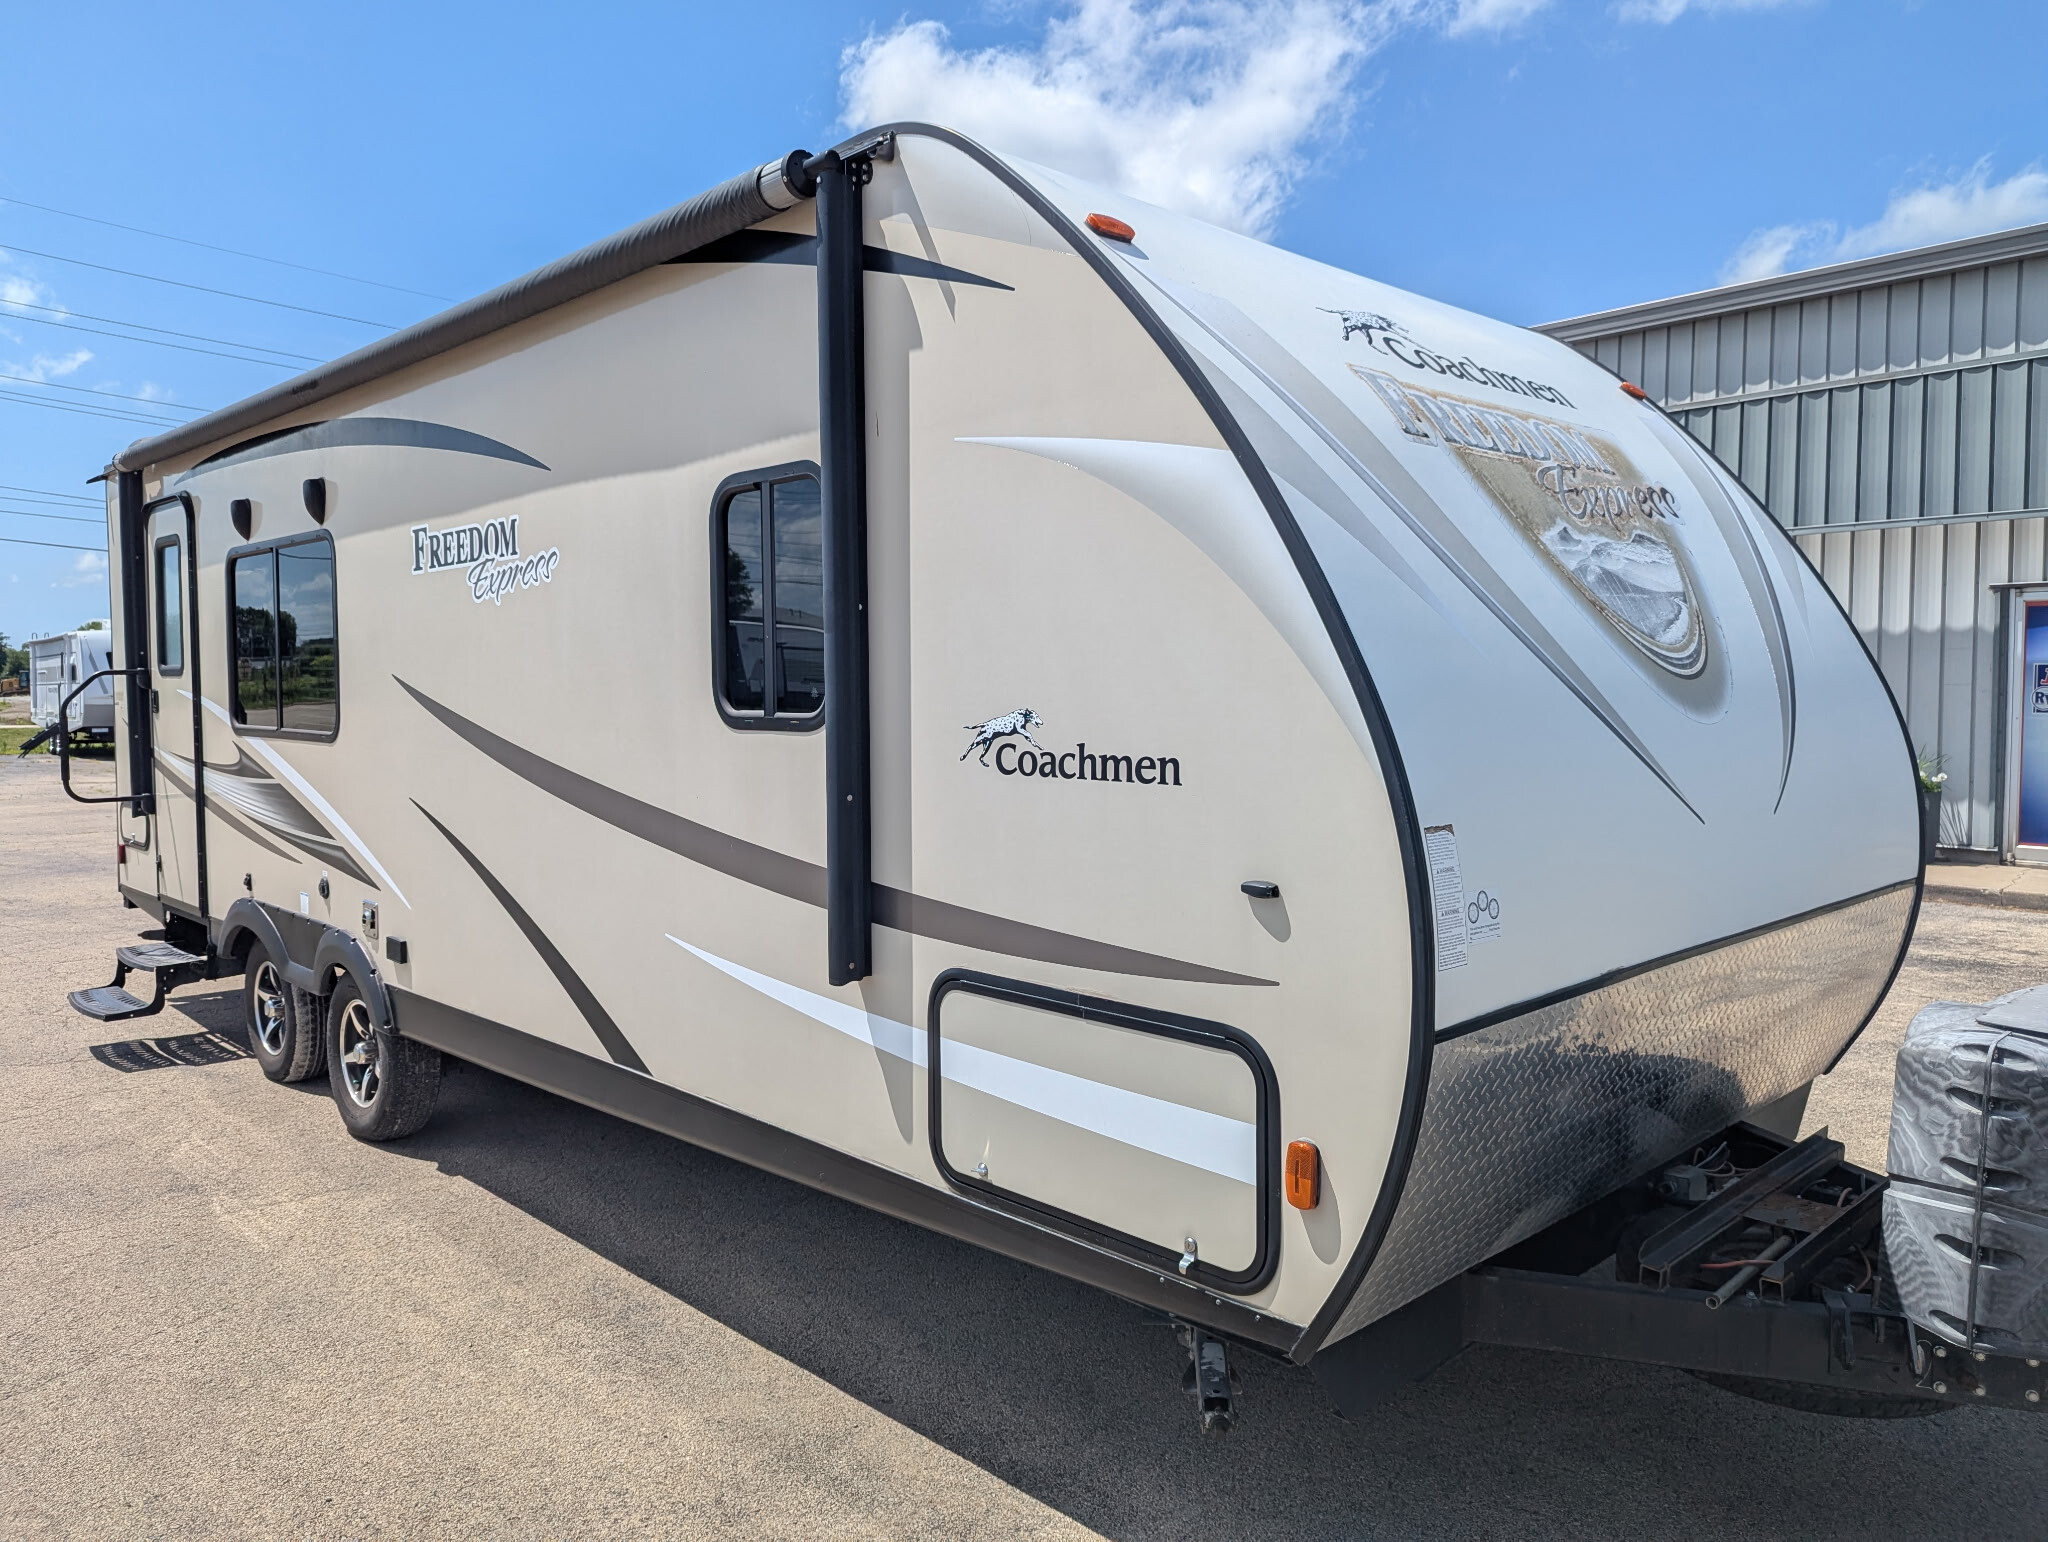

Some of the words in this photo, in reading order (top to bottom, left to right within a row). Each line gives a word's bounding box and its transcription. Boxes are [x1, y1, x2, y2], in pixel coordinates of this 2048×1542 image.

[1382, 336, 1578, 410] Coachmen
[1537, 463, 1680, 533] Express
[411, 517, 519, 572] FREEDOM
[467, 550, 558, 603] Express
[995, 742, 1183, 787] Coachmen
